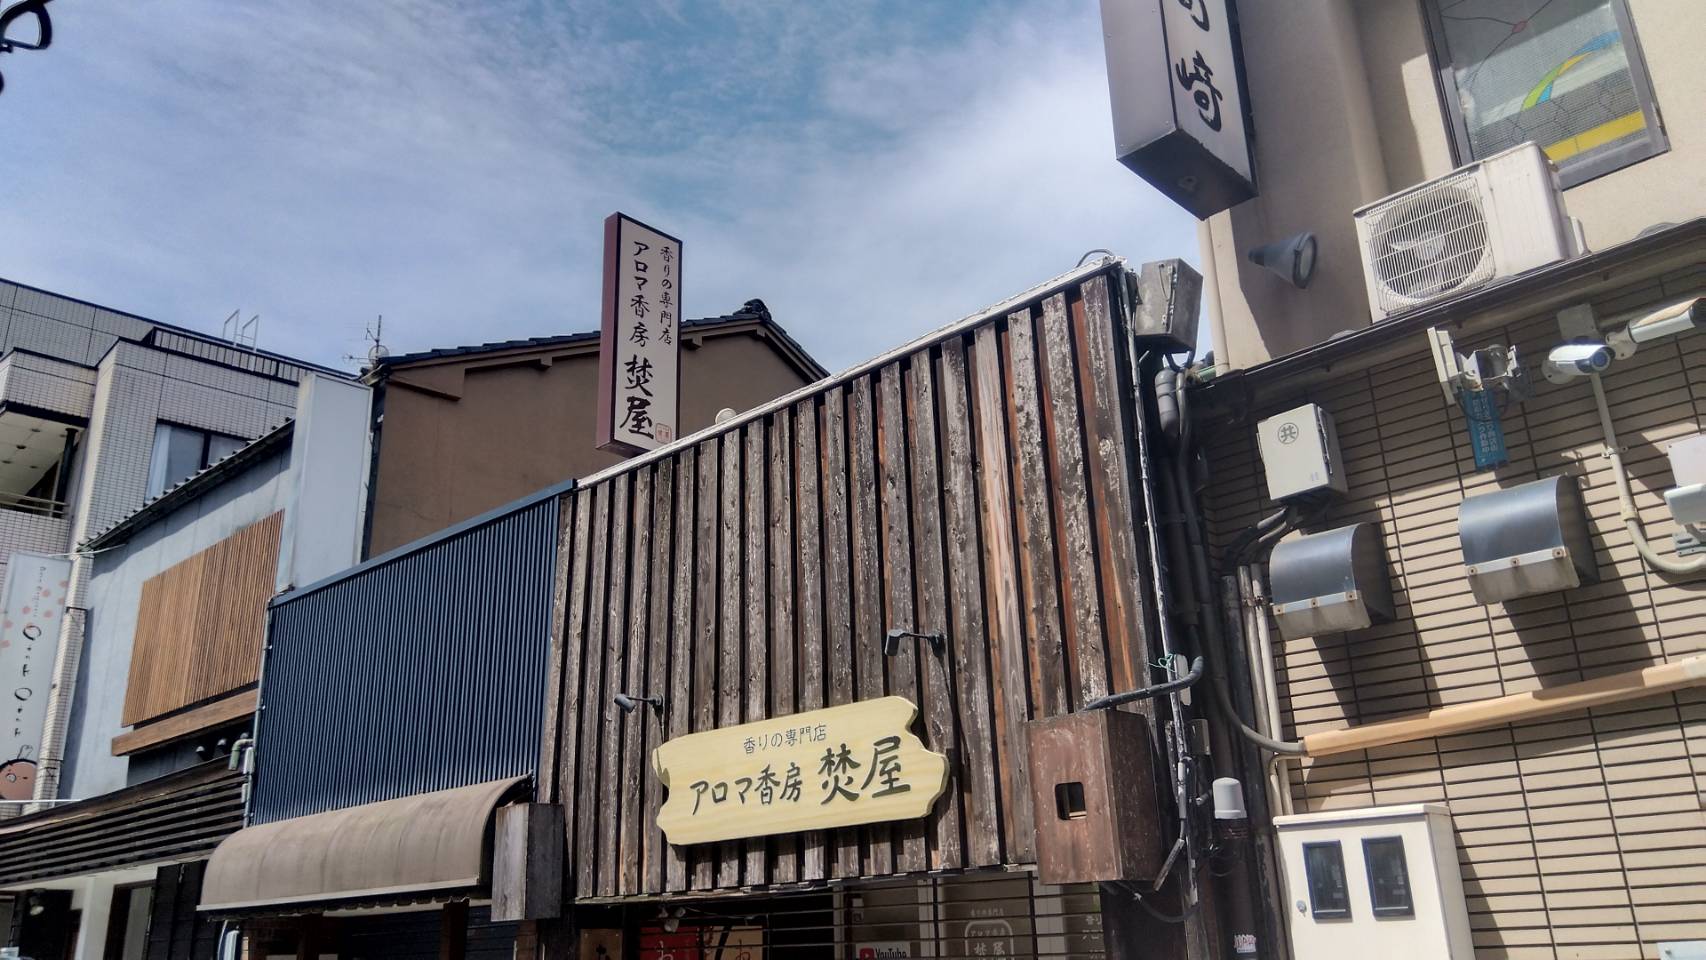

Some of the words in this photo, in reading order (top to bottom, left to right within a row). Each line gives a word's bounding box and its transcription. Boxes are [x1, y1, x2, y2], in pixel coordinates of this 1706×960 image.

[658, 246, 674, 346] 香りの専門店
[619, 354, 655, 440] 焚屋
[689, 762, 804, 816] アロマ香房
[817, 735, 912, 806] 焚屋
[743, 723, 828, 755] 香りの専門店
[875, 947, 907, 959] YouTube
